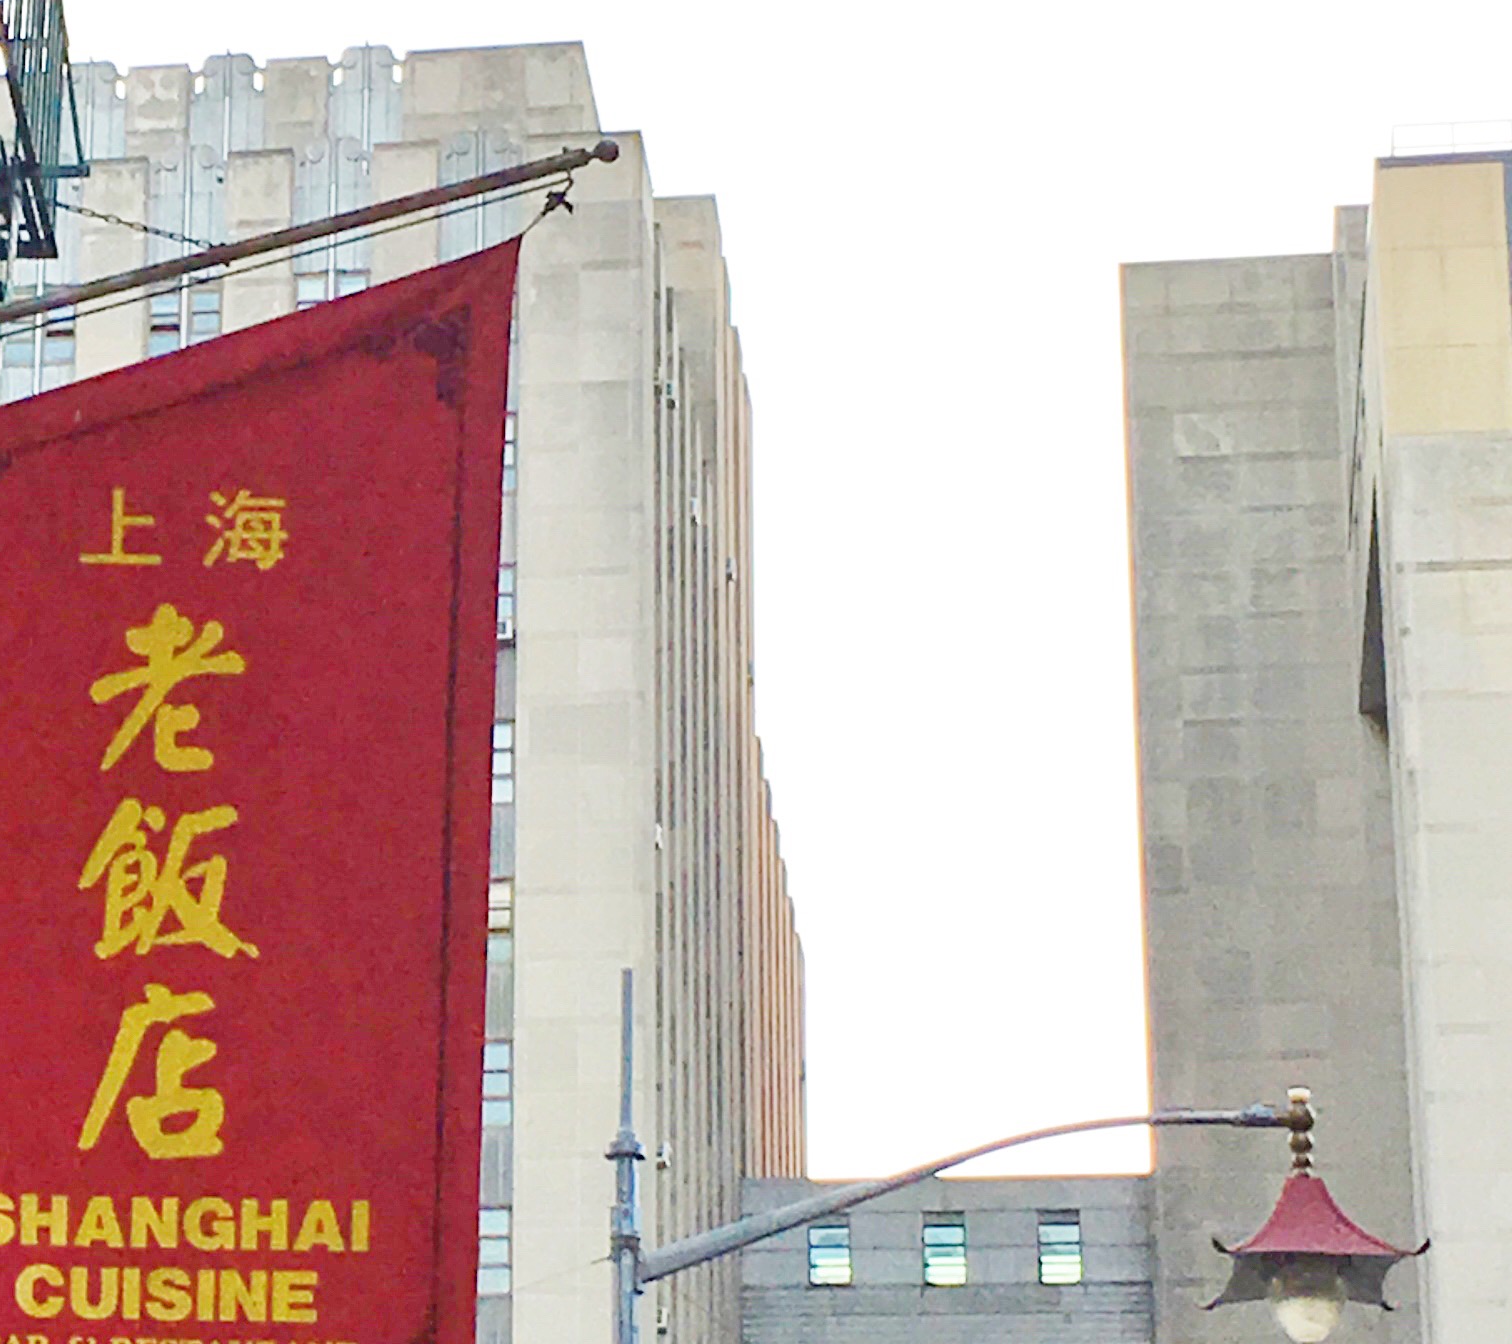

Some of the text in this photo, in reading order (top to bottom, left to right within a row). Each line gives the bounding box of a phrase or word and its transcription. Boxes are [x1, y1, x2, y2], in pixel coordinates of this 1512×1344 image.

[79, 487, 288, 569] 上海
[78, 603, 260, 1160] 老飯店
[14, 1264, 319, 1324] CUISINE
